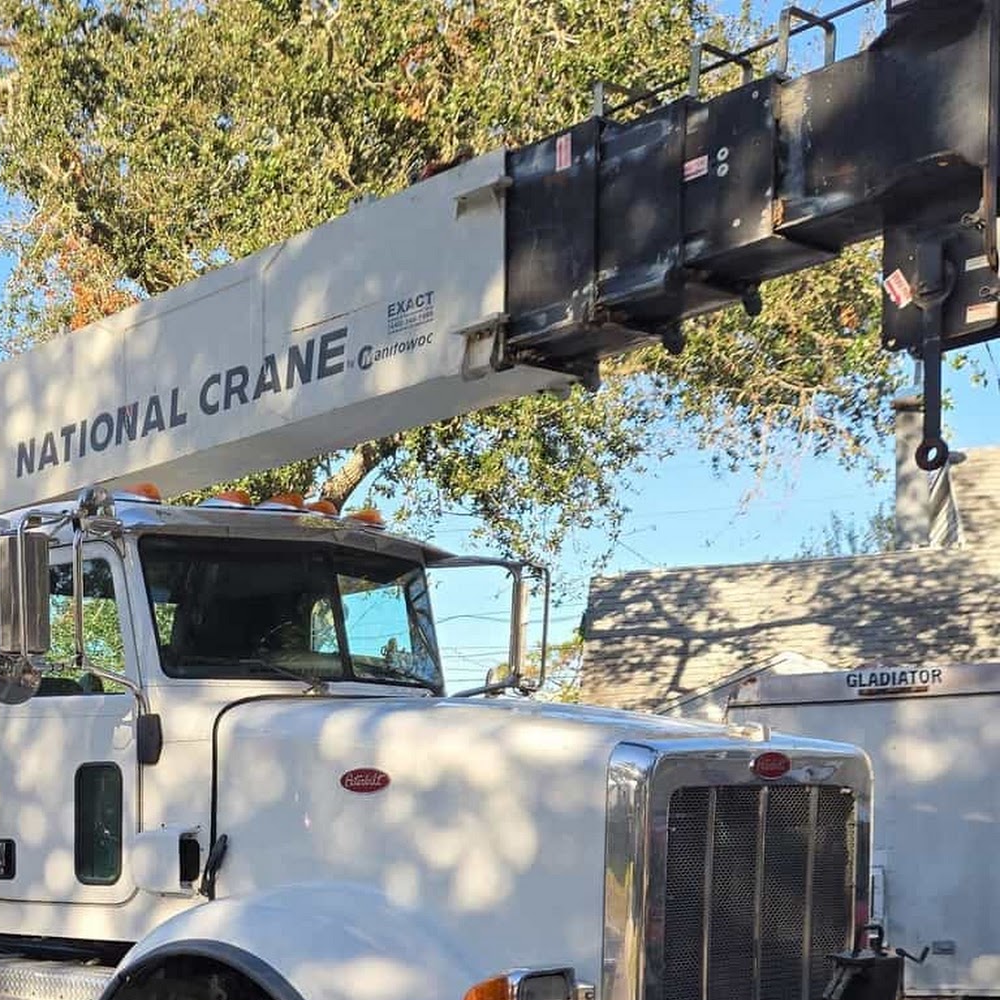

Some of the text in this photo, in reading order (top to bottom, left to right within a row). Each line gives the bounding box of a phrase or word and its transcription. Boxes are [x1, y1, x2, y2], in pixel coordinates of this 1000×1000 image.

[387, 291, 435, 318] EXACT
[16, 327, 349, 477] NATIONAL CRANE
[846, 669, 942, 688] GLADIATOR
